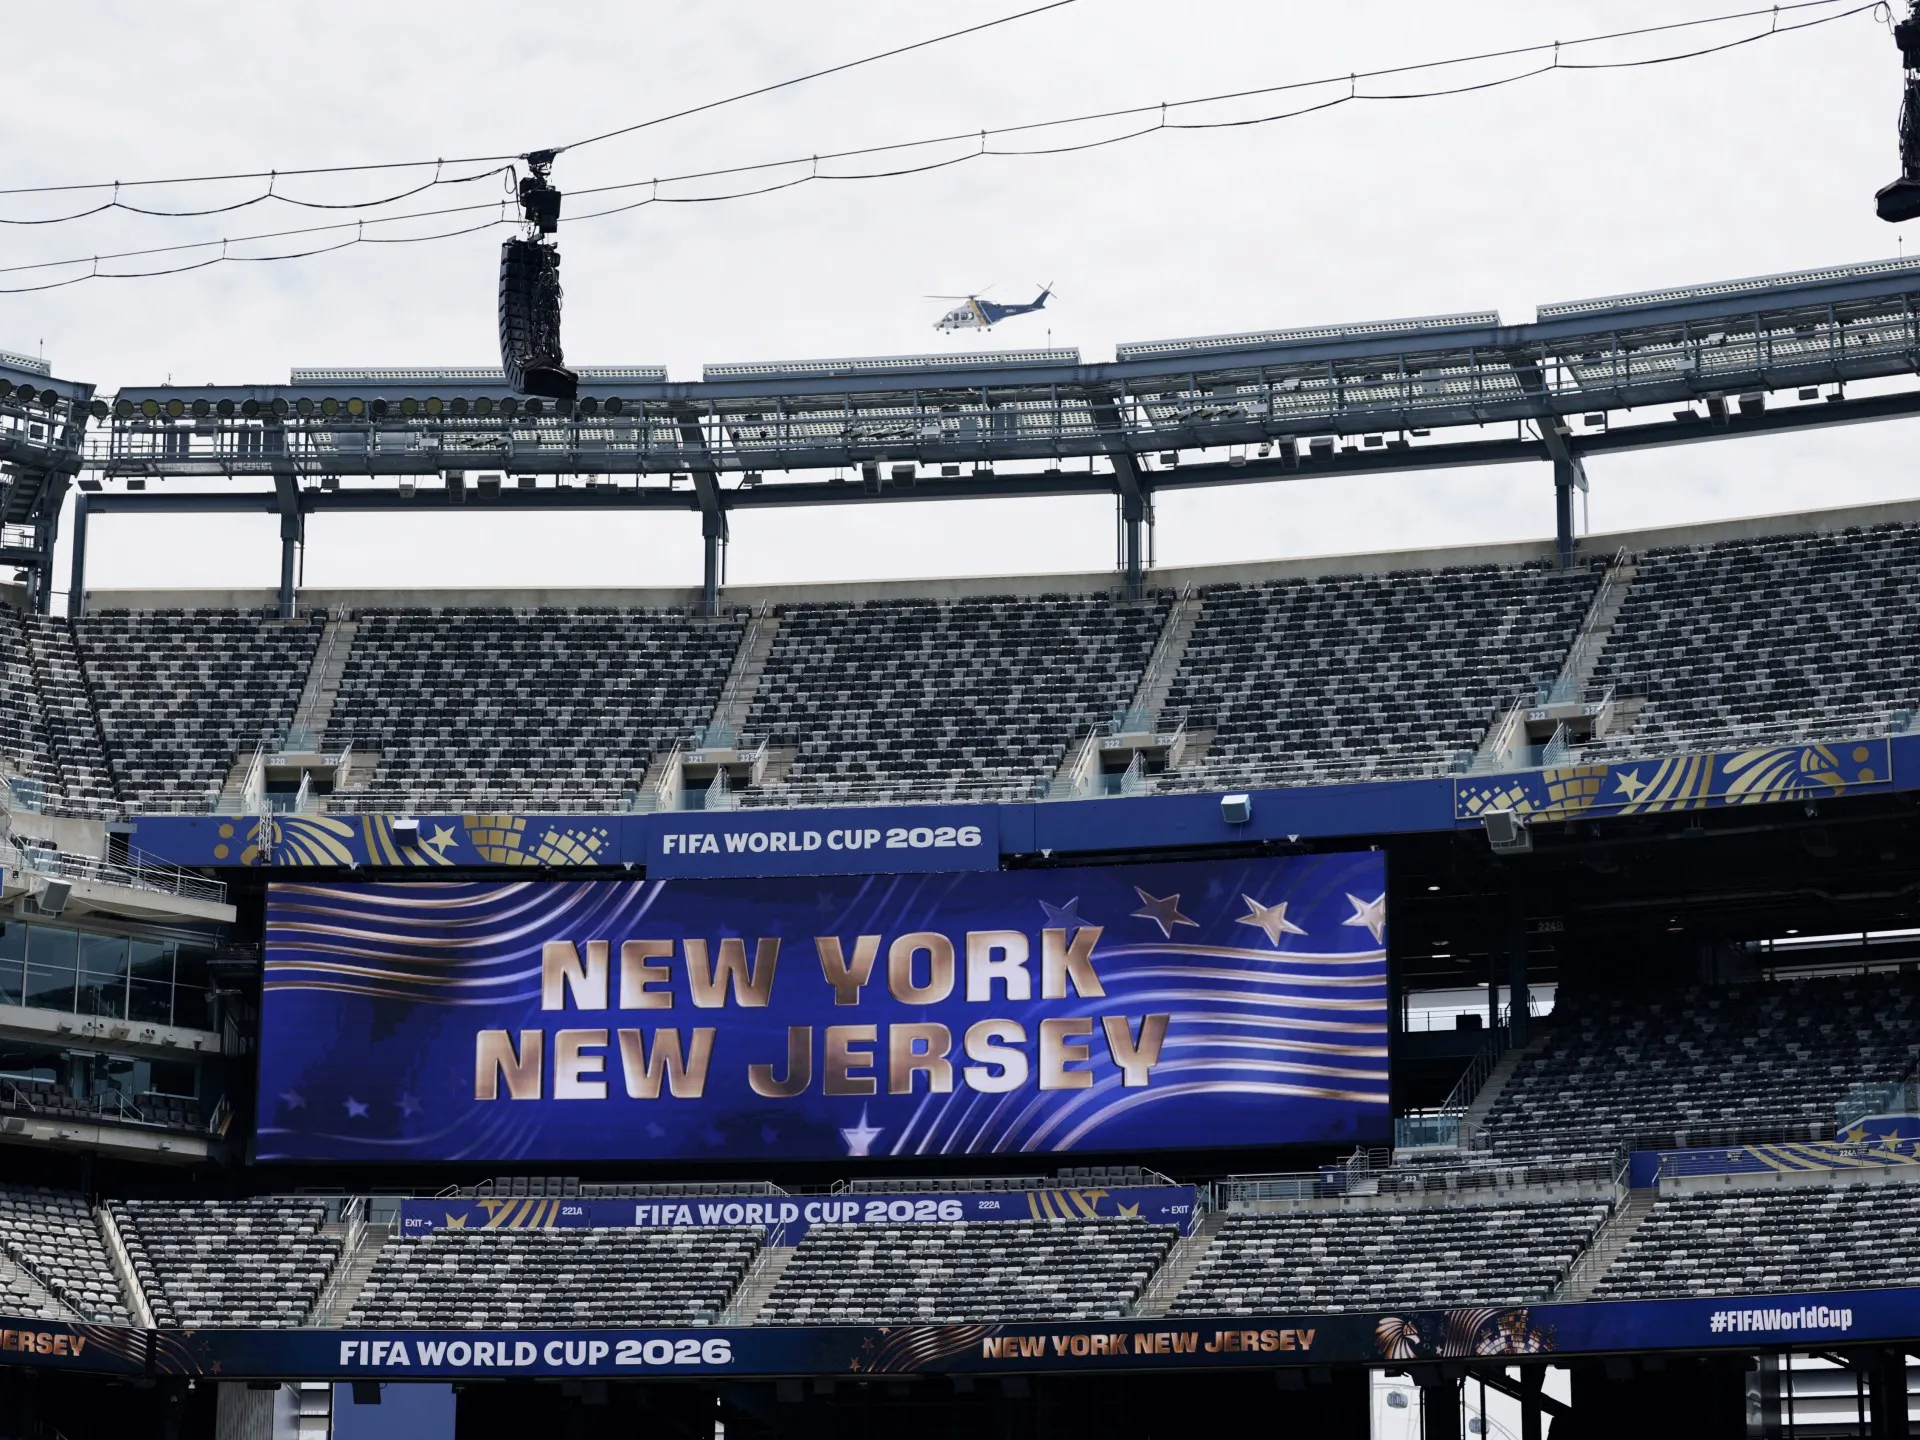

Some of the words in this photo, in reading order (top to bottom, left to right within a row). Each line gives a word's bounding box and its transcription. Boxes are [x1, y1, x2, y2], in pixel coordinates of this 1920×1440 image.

[1530, 712, 1545, 720] 323
[1105, 740, 1120, 748] 322
[270, 757, 286, 765] 320
[324, 757, 339, 765] 321
[688, 755, 703, 763] 321
[663, 832, 719, 854] FIFA
[723, 831, 821, 853] WORLD
[827, 829, 880, 849] CUP
[886, 826, 982, 848] 2026
[541, 937, 783, 1011] NEW
[815, 926, 1108, 1007] YORK
[474, 1026, 718, 1100] NEW
[747, 1014, 1171, 1098] JERSEY
[978, 1200, 1000, 1209] 222A
[562, 1206, 583, 1215] 221A
[635, 1205, 693, 1225] FIFA
[698, 1203, 799, 1224] WORLD
[804, 1202, 860, 1222] CUP
[864, 1200, 963, 1222] 2026
[1171, 1205, 1190, 1214] EXIT
[405, 1219, 423, 1227] EXIT
[1710, 1306, 1853, 1332] #FIFAWorldCup
[982, 1336, 1047, 1358] NEW
[1051, 1334, 1128, 1356] YORK
[1134, 1332, 1199, 1354] NEW
[1204, 1329, 1316, 1352] JERSEY
[339, 1340, 411, 1366] FIFA
[416, 1340, 538, 1366] WORLD
[543, 1340, 609, 1366] CUP
[615, 1338, 731, 1365] 2026
